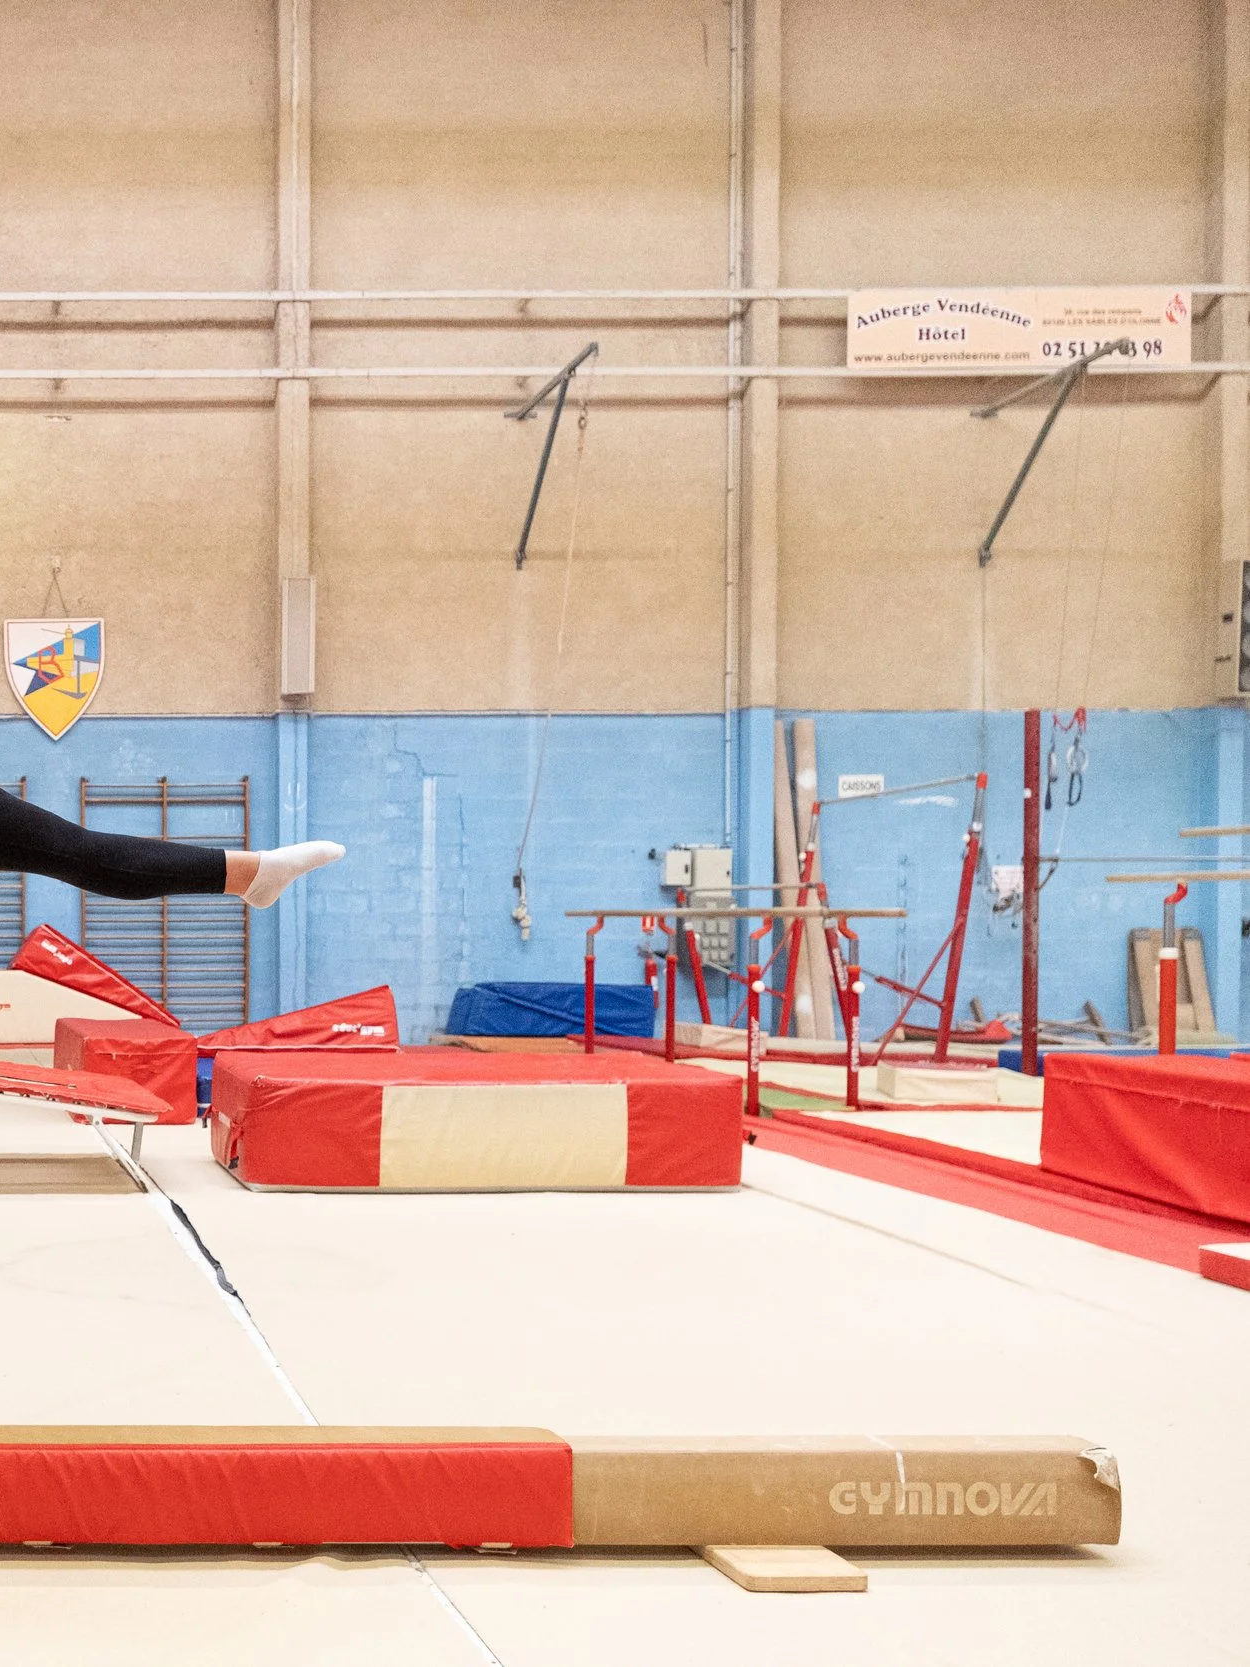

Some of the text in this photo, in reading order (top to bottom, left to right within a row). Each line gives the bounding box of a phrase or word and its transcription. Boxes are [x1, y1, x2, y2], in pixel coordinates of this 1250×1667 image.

[856, 299, 1031, 328] Auberge Vendéenne
[918, 328, 966, 341] Hôtel
[1042, 342, 1062, 356] 02
[1068, 342, 1085, 358] 51
[1143, 340, 1162, 358] 98
[828, 1481, 1058, 1517] GYMNOVA
